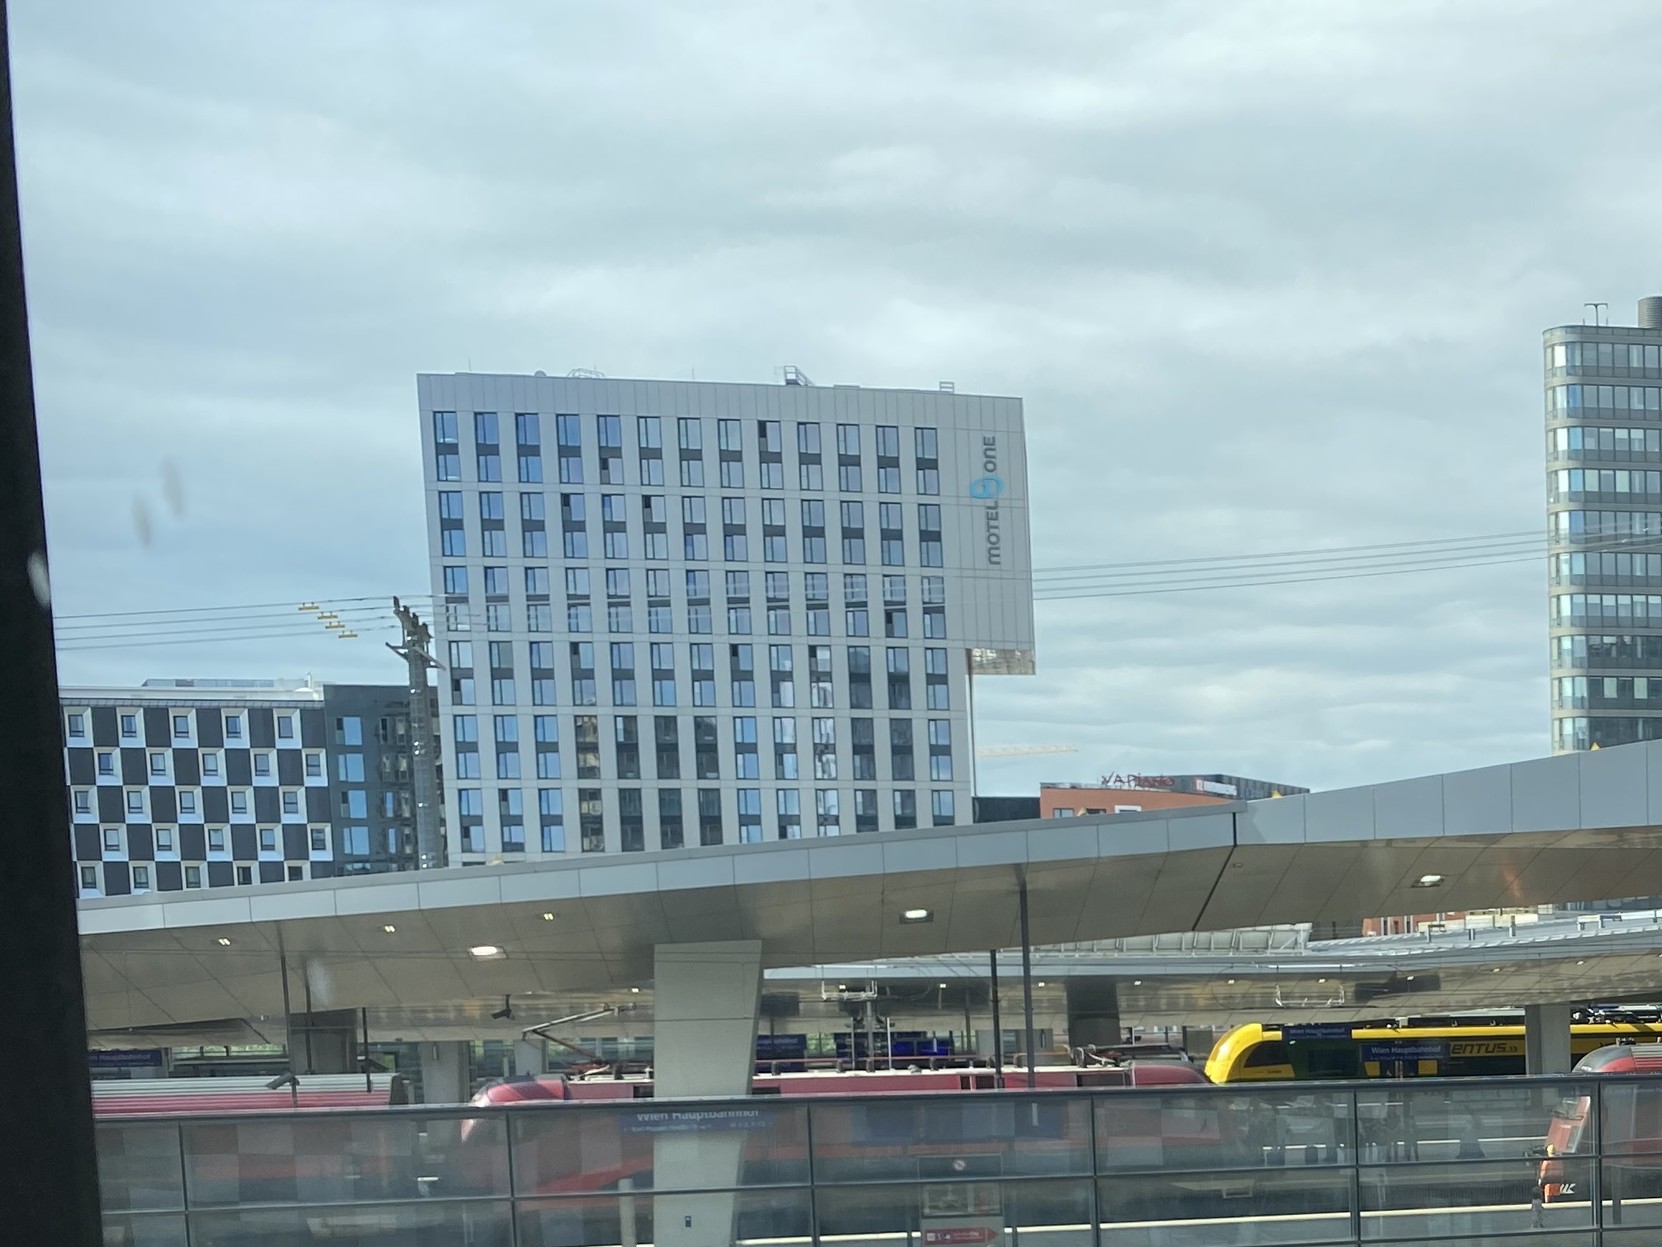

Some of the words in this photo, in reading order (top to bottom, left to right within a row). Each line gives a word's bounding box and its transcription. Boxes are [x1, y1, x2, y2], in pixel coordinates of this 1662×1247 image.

[983, 436, 996, 473] ONE
[986, 500, 1001, 565] MOTEL
[1391, 1045, 1441, 1055] Hauptbahnhof
